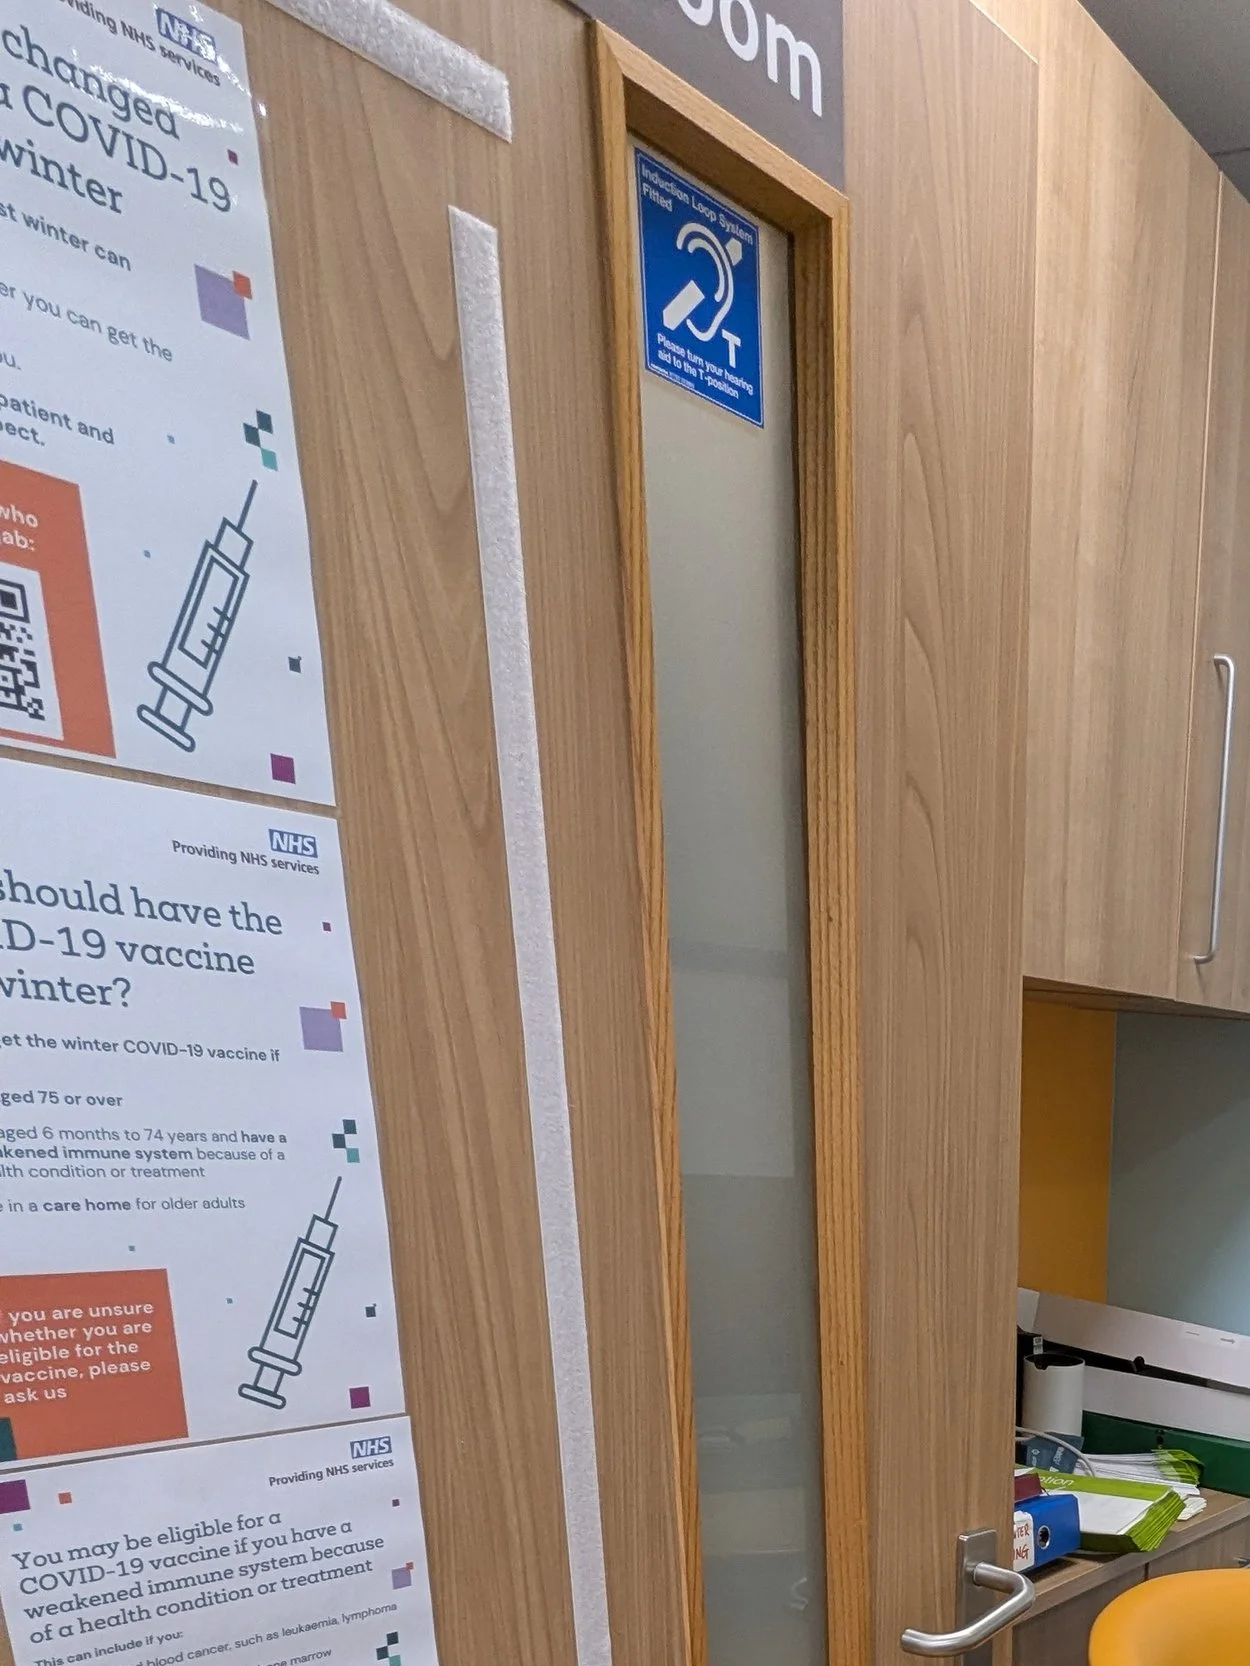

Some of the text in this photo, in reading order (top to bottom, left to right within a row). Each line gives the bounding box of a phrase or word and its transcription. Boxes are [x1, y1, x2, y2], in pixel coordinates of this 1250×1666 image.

[121, 24, 220, 86] NHS services
[3, 25, 180, 139] changed
[23, 86, 231, 212] COVID-19
[642, 182, 673, 212] Fitted
[642, 164, 753, 242] Induction Loop System
[22, 212, 131, 271] winter can
[23, 292, 61, 318] you
[67, 310, 102, 333] can
[107, 326, 138, 348] get
[142, 337, 172, 361] the
[657, 332, 686, 358] Please
[686, 349, 705, 368] turn
[705, 360, 724, 378] your
[724, 369, 754, 396] hearing
[721, 328, 742, 369] T
[658, 349, 671, 364] aid
[673, 355, 683, 369] to
[683, 361, 697, 377] the
[698, 368, 740, 400] T-position
[78, 422, 114, 444] and
[173, 841, 319, 875] Providing NHS services
[272, 831, 316, 856] NHS
[0, 869, 282, 935] hould have the
[0, 919, 255, 974] D-19 vaccine
[26, 1034, 279, 1061] the winter COVID-19 vaccine if
[37, 1091, 122, 1106] 75 or over
[42, 1127, 54, 1139] 6
[59, 1128, 120, 1141] months
[124, 1130, 140, 1141] to
[144, 1129, 163, 1141] 74
[167, 1132, 207, 1144] years
[212, 1131, 238, 1142] and
[241, 1130, 275, 1143] have
[279, 1135, 287, 1143] a
[63, 1148, 285, 1162] immune system because of a
[28, 1165, 205, 1178] condition or treatment
[9, 1197, 245, 1212] in a care home for older adults
[8, 1304, 153, 1326] you are unsure
[83, 1326, 117, 1341] you
[123, 1323, 152, 1334] are
[75, 1344, 102, 1357] for
[107, 1341, 138, 1354] the
[0, 1361, 150, 1383] vaccine, please
[5, 1388, 67, 1403] ask us
[352, 1438, 391, 1458] NHS
[269, 1459, 394, 1486] Providing NHS services
[11, 1513, 281, 1569] You may be eligible for a
[20, 1523, 352, 1594] COVID-19 vaccine if you have a
[24, 1538, 384, 1619] weakened immune system because
[30, 1560, 373, 1643] of a health condition or treatment
